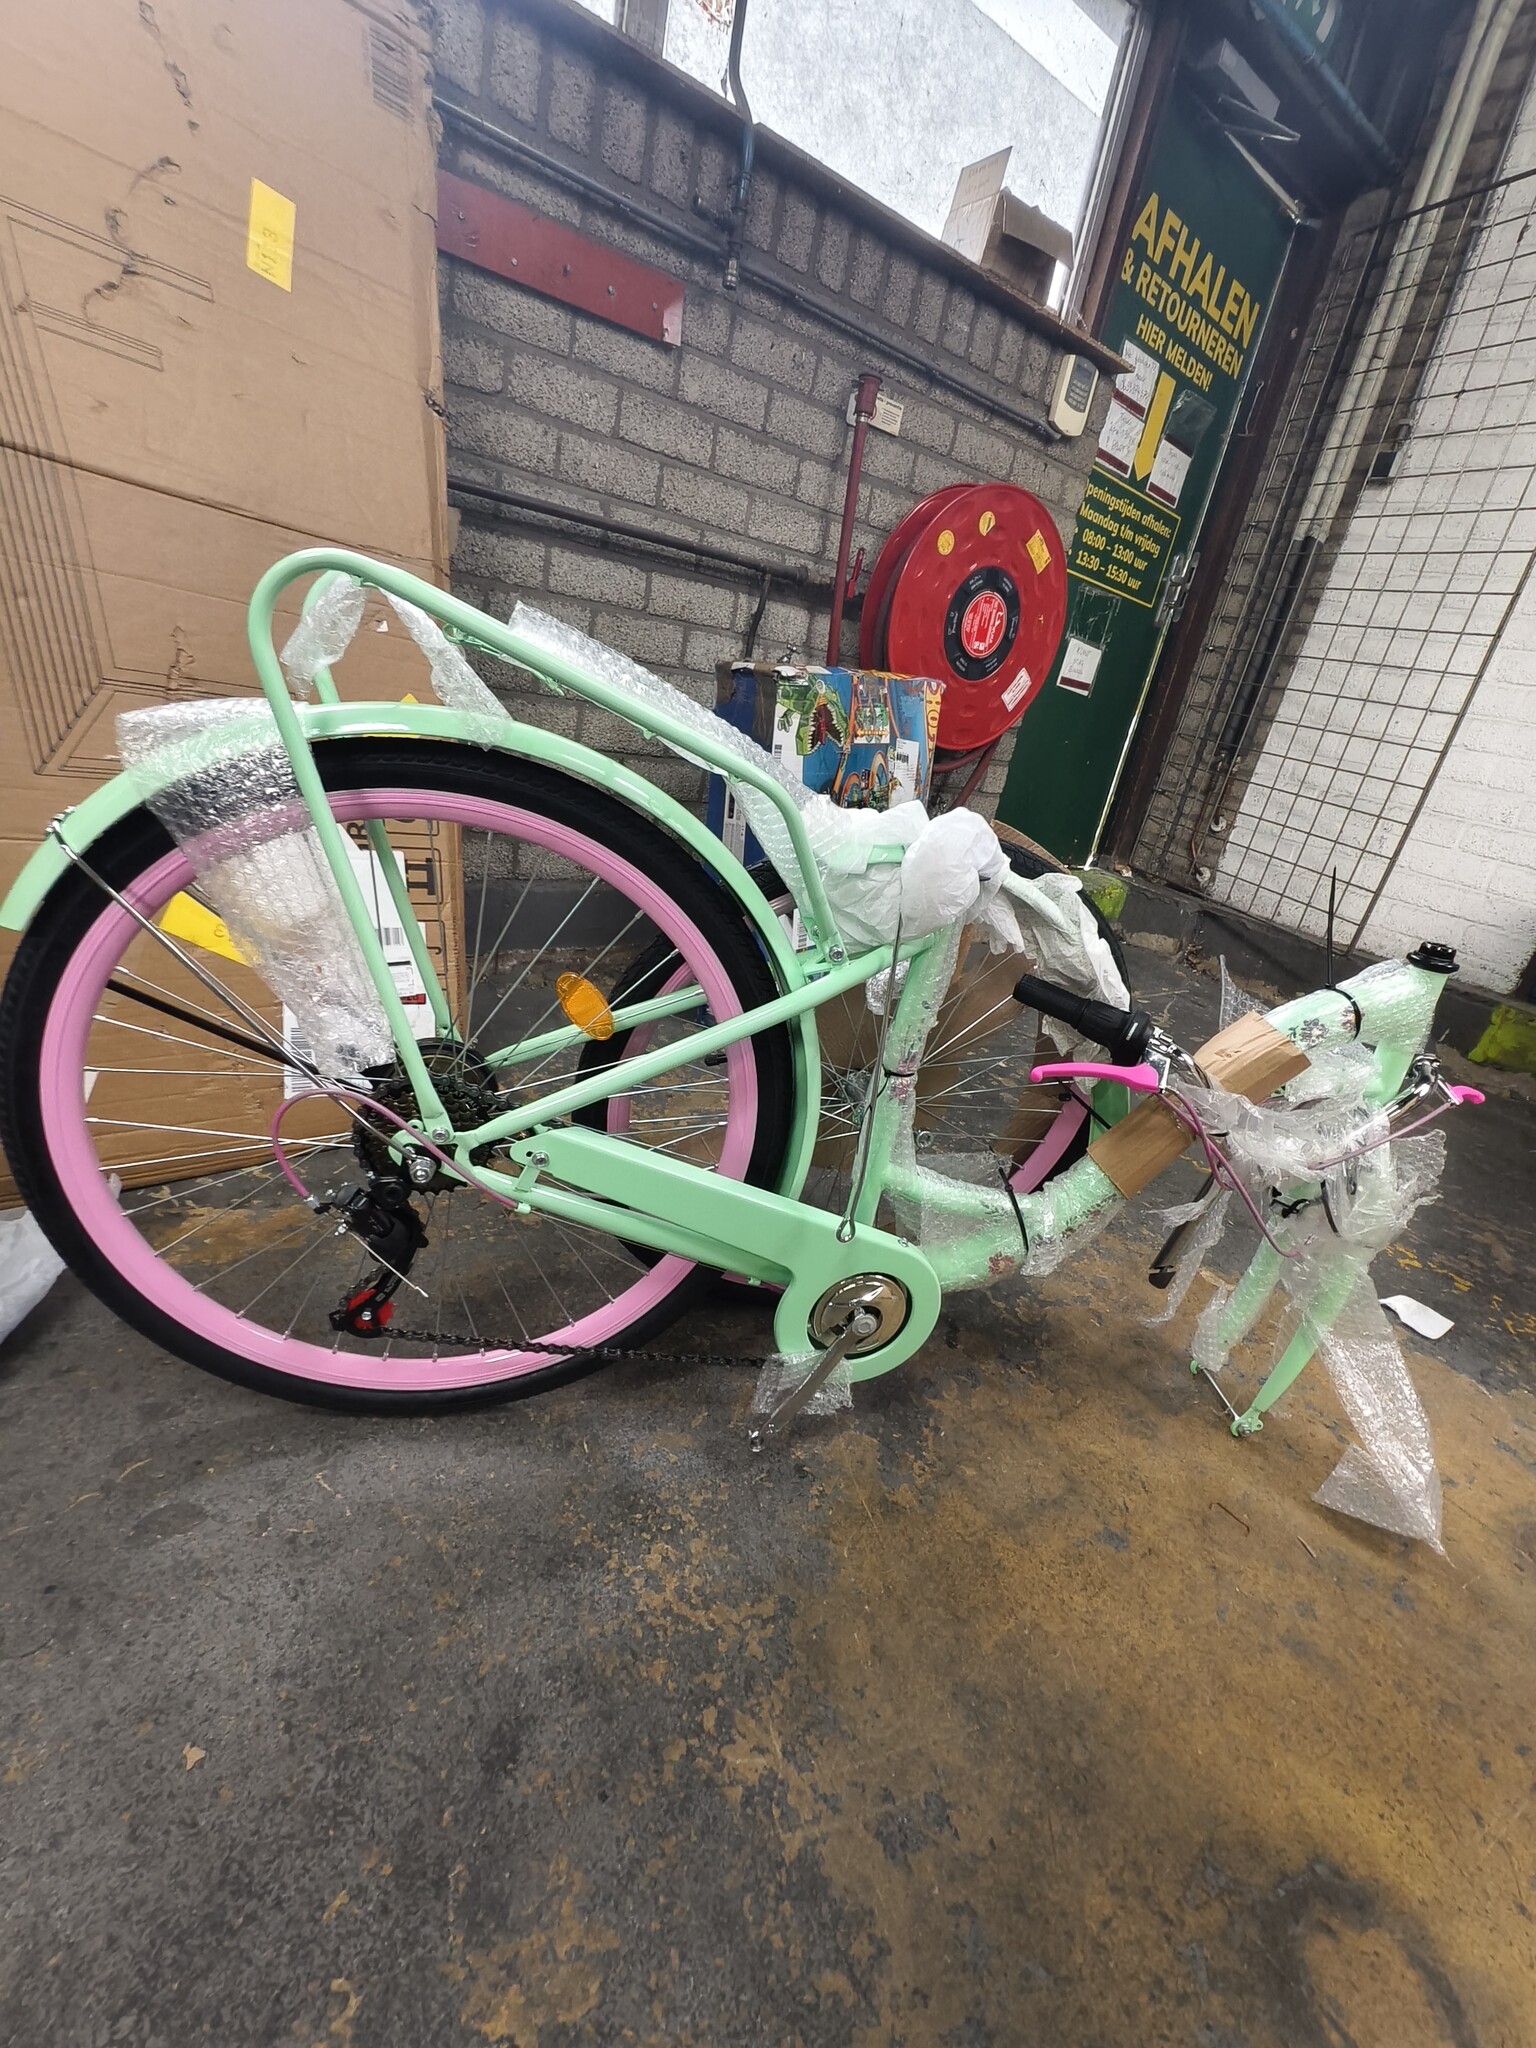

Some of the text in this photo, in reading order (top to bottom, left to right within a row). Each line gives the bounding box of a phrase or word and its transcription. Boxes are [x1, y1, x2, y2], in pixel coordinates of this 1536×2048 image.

[1131, 191, 1261, 350] AFHALEN
[1120, 247, 1244, 380] & RETOURNEREN
[1135, 313, 1167, 354] HIER
[1164, 338, 1214, 393] MELDEN!
[1079, 501, 1161, 559] Maandag t/m vrijdag
[1084, 479, 1172, 539] peningstijden afhalen:
[1075, 550, 1100, 572] 13:30
[1105, 563, 1129, 585] 15:30
[1127, 576, 1143, 591] uur
[1082, 528, 1107, 551] 08:00
[1111, 543, 1135, 565] 13:00
[1133, 556, 1149, 572] uur
